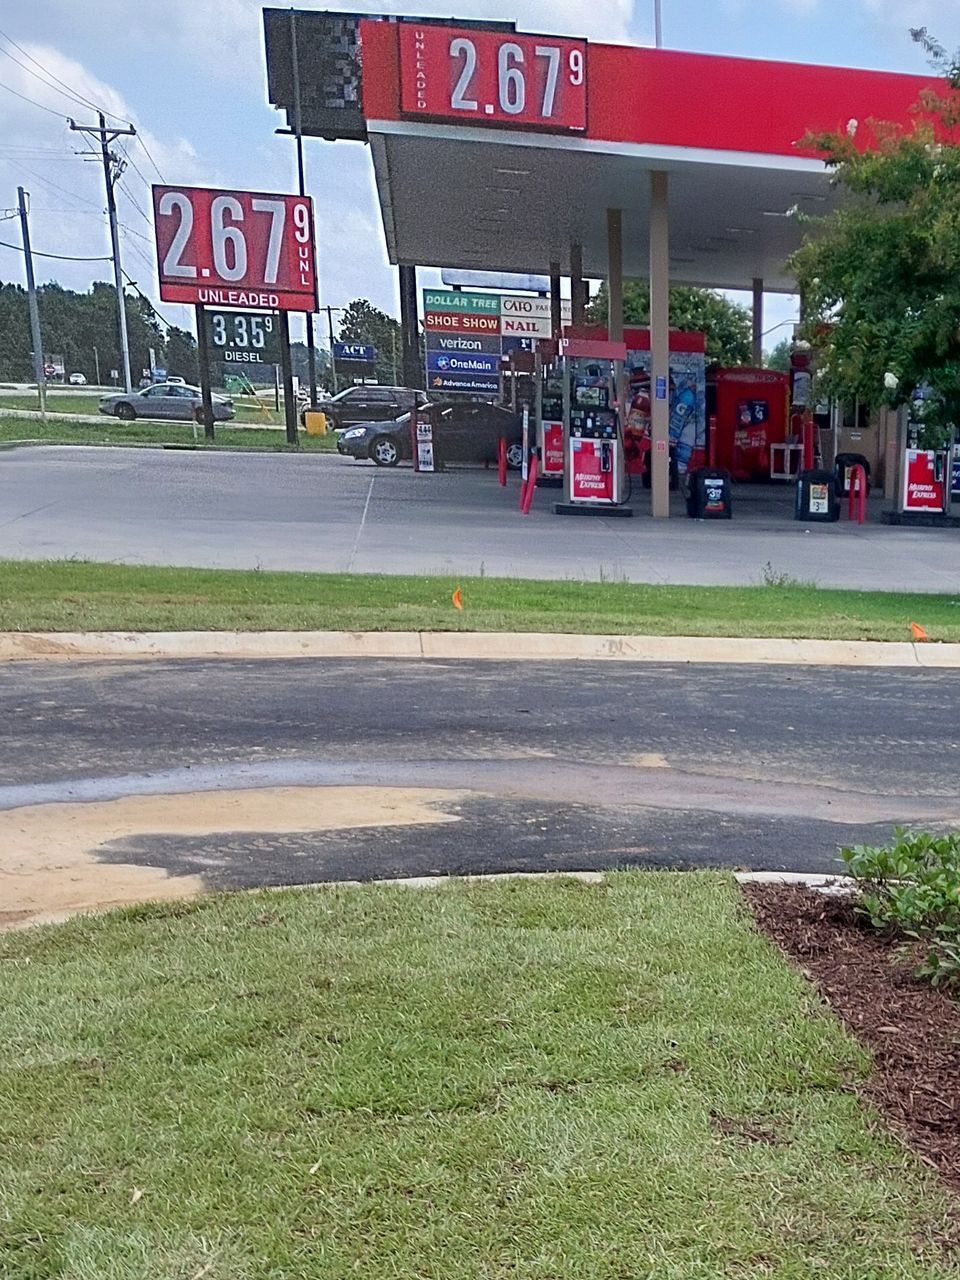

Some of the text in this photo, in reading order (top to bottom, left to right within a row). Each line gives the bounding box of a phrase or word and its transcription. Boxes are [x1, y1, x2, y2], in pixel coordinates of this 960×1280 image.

[415, 31, 427, 109] UNLEADED
[298, 246, 311, 286] UNL
[198, 288, 279, 307] UNLEADED
[426, 295, 498, 309] DOLLAR TREE
[427, 315, 498, 329] SHOE SHOW
[505, 320, 539, 332] NAIL
[342, 345, 366, 355] ACT
[440, 337, 482, 350] verizon
[224, 351, 264, 363] DIESEL
[450, 358, 492, 370] OneMain
